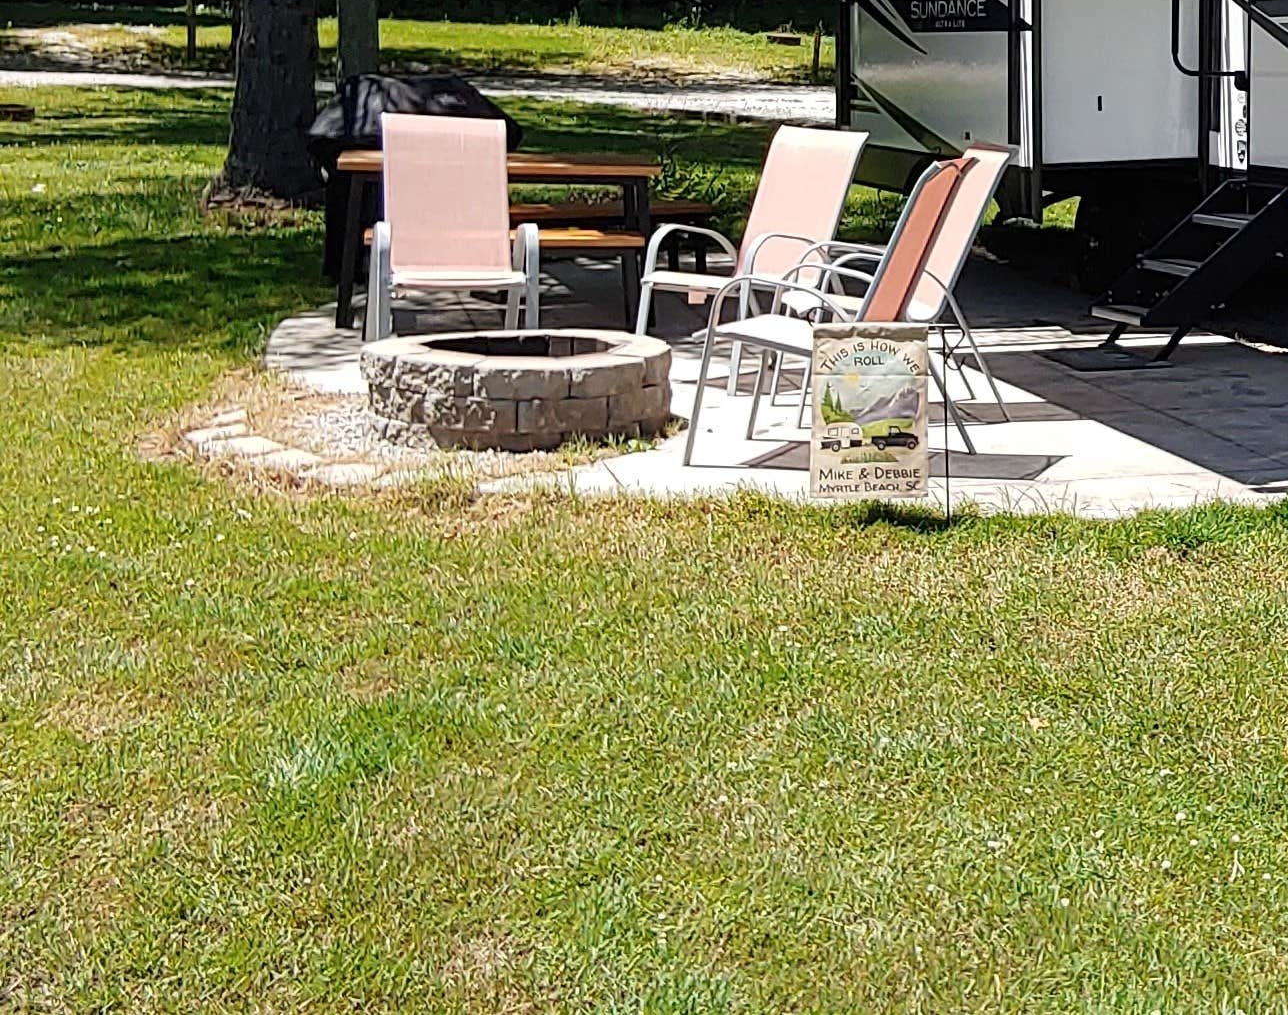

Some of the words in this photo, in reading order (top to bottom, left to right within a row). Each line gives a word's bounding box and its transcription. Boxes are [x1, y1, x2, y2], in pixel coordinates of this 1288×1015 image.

[820, 348, 849, 372] THIS
[853, 342, 865, 353] IS
[871, 341, 901, 356] HOW
[903, 353, 920, 373] WE
[854, 356, 885, 366] ROLL
[859, 467, 870, 480] &
[905, 480, 921, 492] SC
